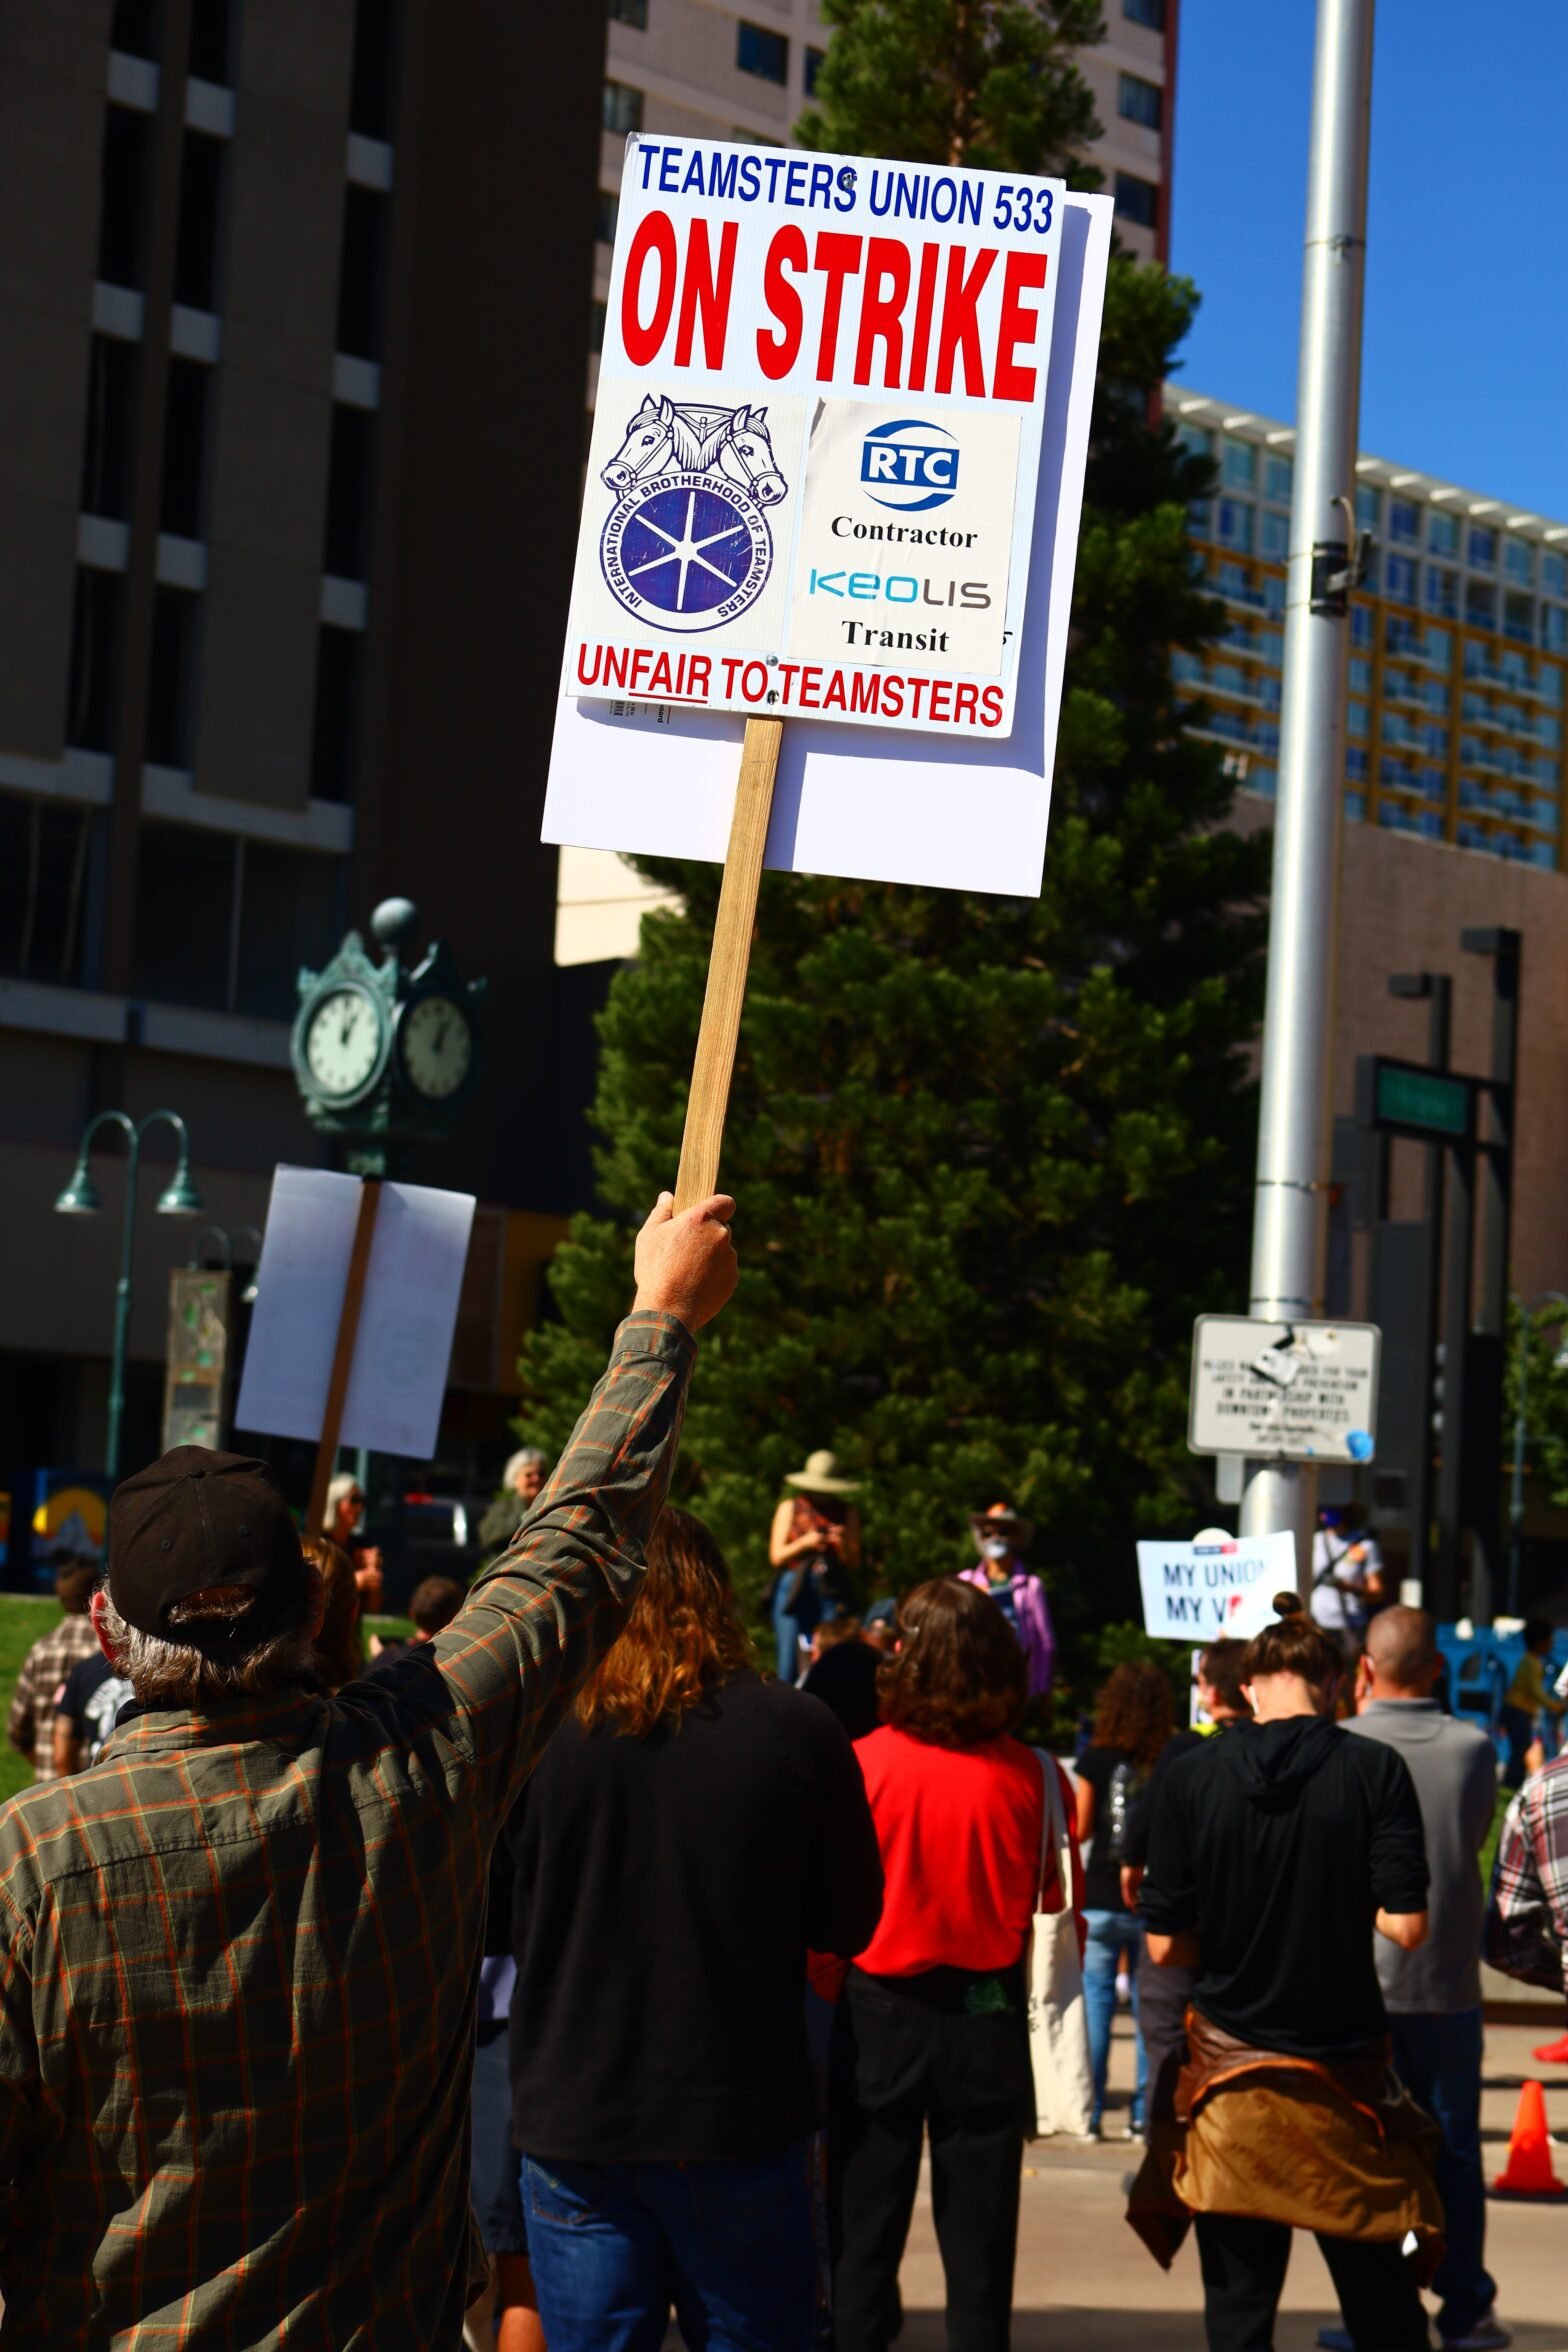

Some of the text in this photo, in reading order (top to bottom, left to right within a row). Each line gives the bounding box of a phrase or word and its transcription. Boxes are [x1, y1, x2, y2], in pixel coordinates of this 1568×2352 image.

[638, 144, 1055, 235] TEAMSTERS UNION 533
[620, 209, 1049, 403] ON STRIKE
[867, 446, 953, 486] RTC
[606, 475, 767, 617] INTERNATIONAL BROTHERHOOD OF TEAMSTERS
[831, 515, 978, 549] Contractor
[841, 620, 951, 652] Transit
[577, 642, 1005, 728] UNFAIR TO TEAMSTERS
[1163, 1563, 1195, 1587] MY
[1166, 1595, 1202, 1623] MY
